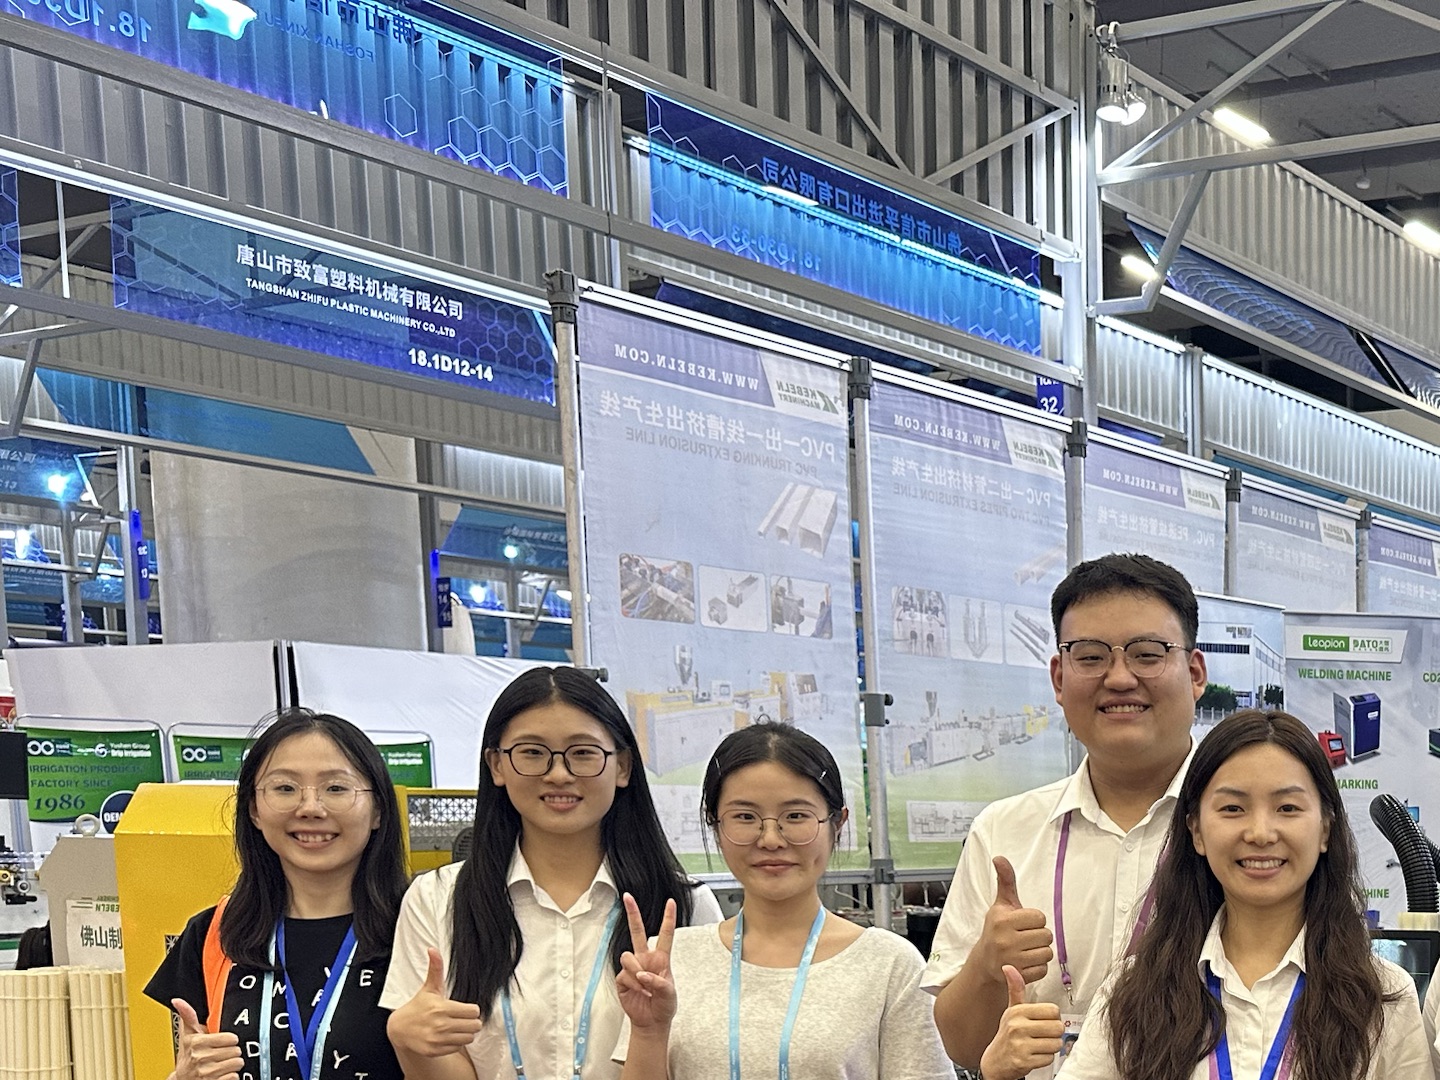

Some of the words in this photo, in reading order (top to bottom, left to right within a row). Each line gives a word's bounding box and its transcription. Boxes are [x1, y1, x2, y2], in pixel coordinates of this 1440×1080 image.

[236, 244, 463, 320] 唐山市致富塑料机械有限公司
[246, 278, 299, 299] TANGSHAN
[300, 292, 328, 307] ZHIFU
[330, 300, 369, 316] PLASTIC
[370, 309, 422, 329] MACHINERY
[408, 348, 494, 382] 18.1D12-14
[1040, 396, 1059, 413] 32
[1308, 636, 1346, 651] Leapion
[1353, 639, 1378, 649] DATO
[1298, 668, 1344, 680] WELDING
[1346, 669, 1392, 681] MACHINE
[132, 743, 151, 751] Group
[29, 764, 87, 774] IRRIGATION
[30, 779, 80, 788] FACTORY
[83, 779, 113, 788] SINCE
[34, 793, 86, 813] 1986
